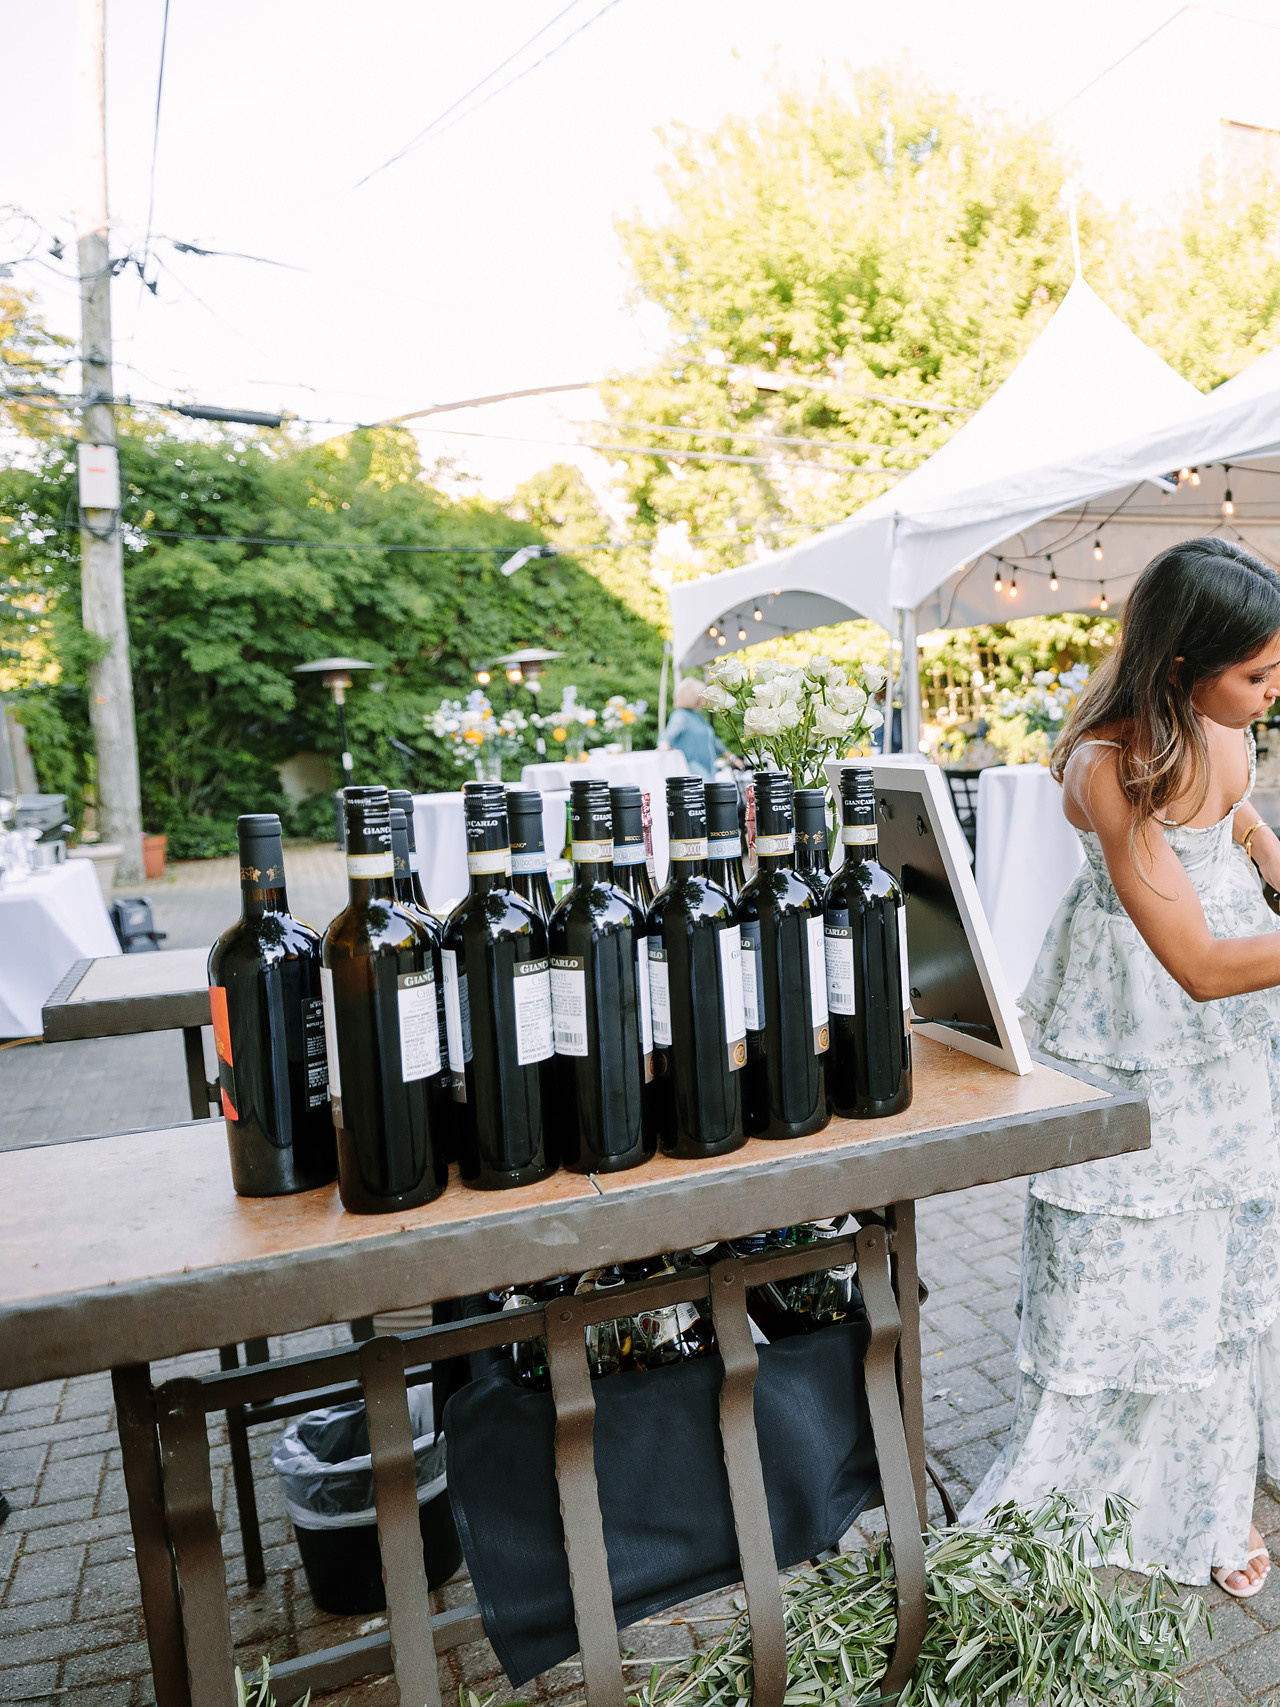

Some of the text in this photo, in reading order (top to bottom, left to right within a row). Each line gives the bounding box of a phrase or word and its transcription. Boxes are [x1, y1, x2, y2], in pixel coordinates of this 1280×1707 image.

[825, 928, 849, 937] CARLO
[551, 958, 579, 968] CARLO
[404, 973, 435, 987] GIANC
